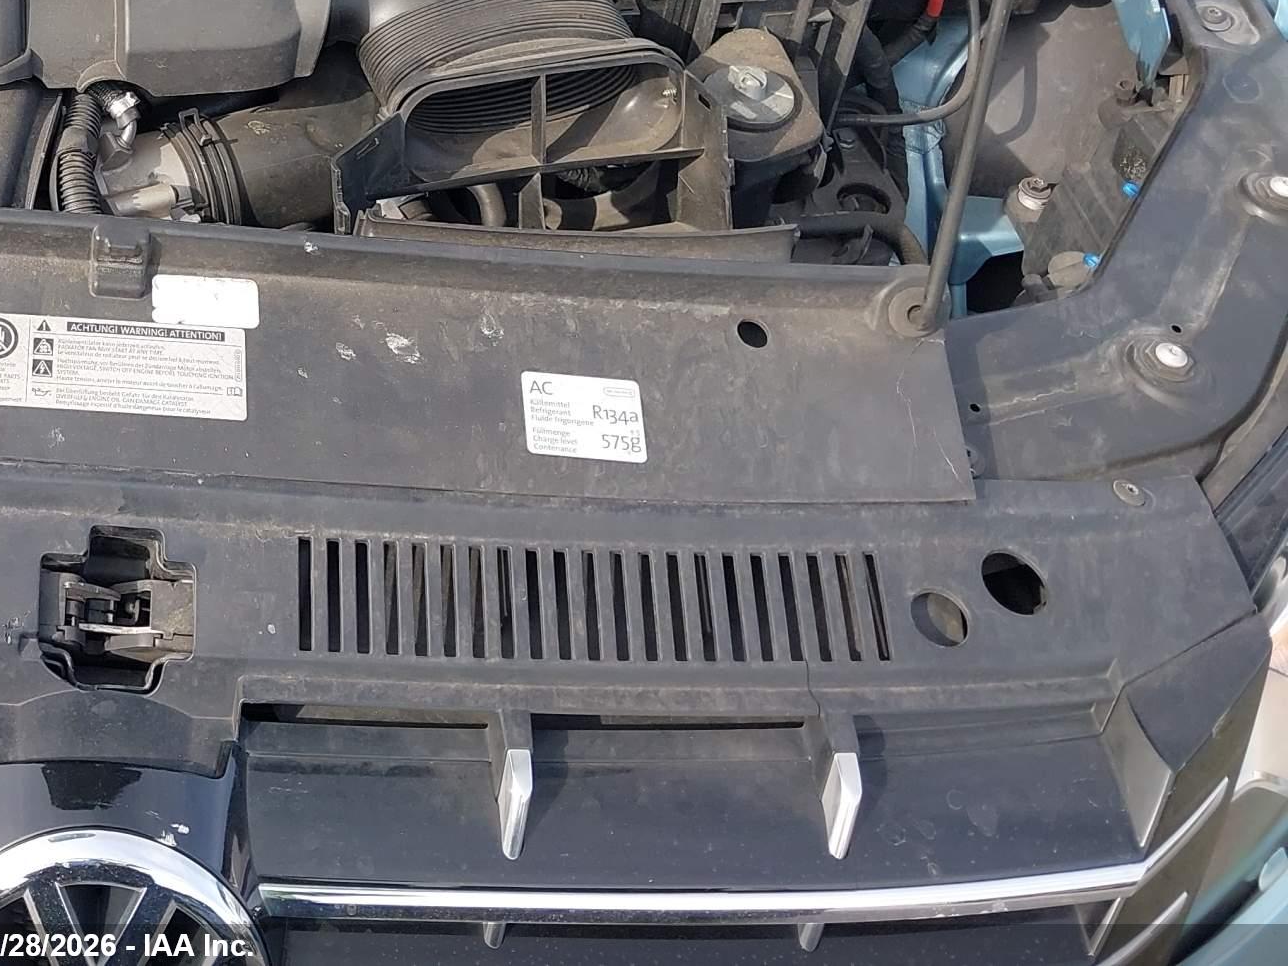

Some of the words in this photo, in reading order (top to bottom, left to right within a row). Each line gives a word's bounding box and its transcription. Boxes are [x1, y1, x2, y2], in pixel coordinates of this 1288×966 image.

[71, 323, 118, 333] ACHTUNG!
[120, 326, 168, 336] WARNING!
[170, 329, 222, 340] ATTENTION!
[530, 380, 553, 395] AC
[530, 407, 571, 416] Refrigerant
[593, 405, 639, 425] R134a
[533, 435, 559, 444] Charge
[602, 434, 642, 453] 575g
[534, 443, 577, 453] Contenance
